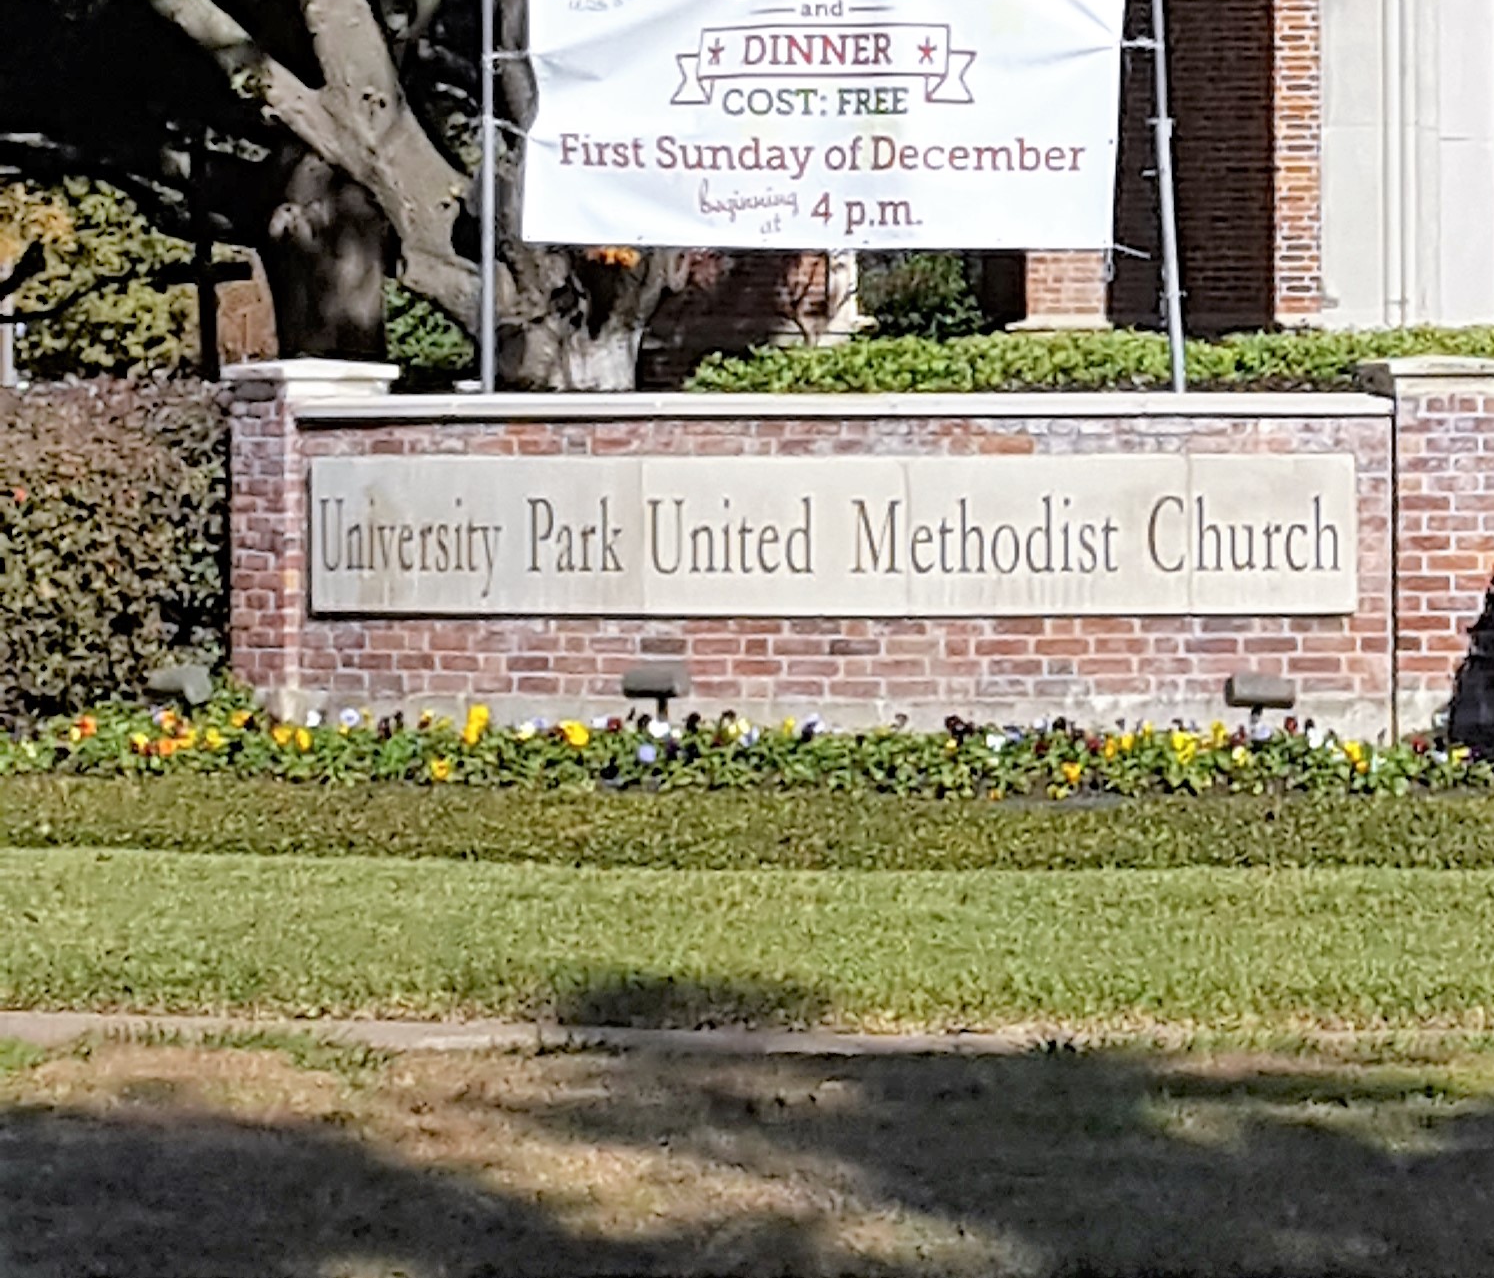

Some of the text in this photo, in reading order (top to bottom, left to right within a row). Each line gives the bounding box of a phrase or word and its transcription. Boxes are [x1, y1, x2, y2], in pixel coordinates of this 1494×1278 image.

[800, 0, 843, 17] and
[742, 33, 893, 66] DINNER
[721, 87, 909, 116] COST: FREE
[559, 133, 1087, 180] First Sunday of December
[698, 178, 799, 222] beginning
[811, 192, 923, 235] 4 p.m.
[760, 213, 782, 234] at
[318, 494, 1342, 598] University Park United Methodist Church
